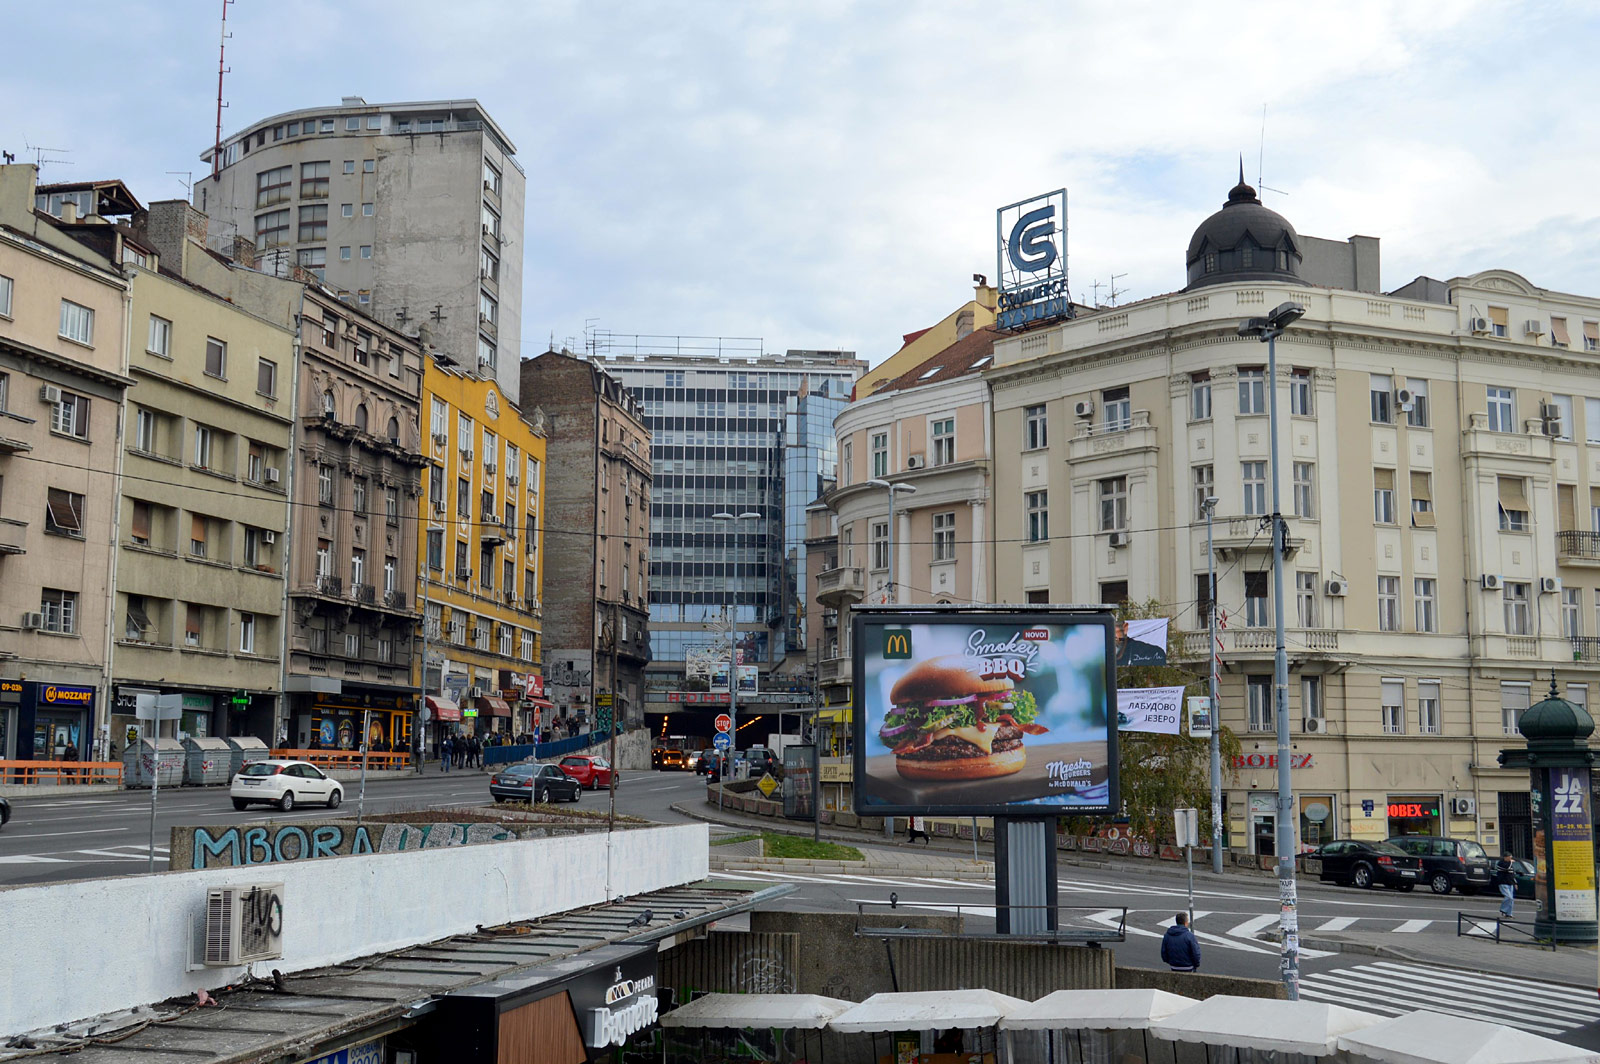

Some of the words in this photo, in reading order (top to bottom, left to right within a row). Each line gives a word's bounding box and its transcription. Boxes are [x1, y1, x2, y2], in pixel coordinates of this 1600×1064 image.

[998, 298, 1064, 327] SYSTEM
[1025, 631, 1047, 639] NOVO!
[964, 629, 1038, 663] Smokey
[978, 658, 1026, 682] BBQ
[57, 690, 92, 701] MOZZART
[1128, 702, 1176, 712] ЛАБУДОВО
[1144, 714, 1176, 724] ЈЕЗЕРО
[1045, 757, 1092, 780] Maestro
[1554, 774, 1584, 795] JA
[1554, 794, 1582, 813] ZZ
[634, 975, 654, 993] PEKARA
[593, 994, 659, 1049] Baguette
